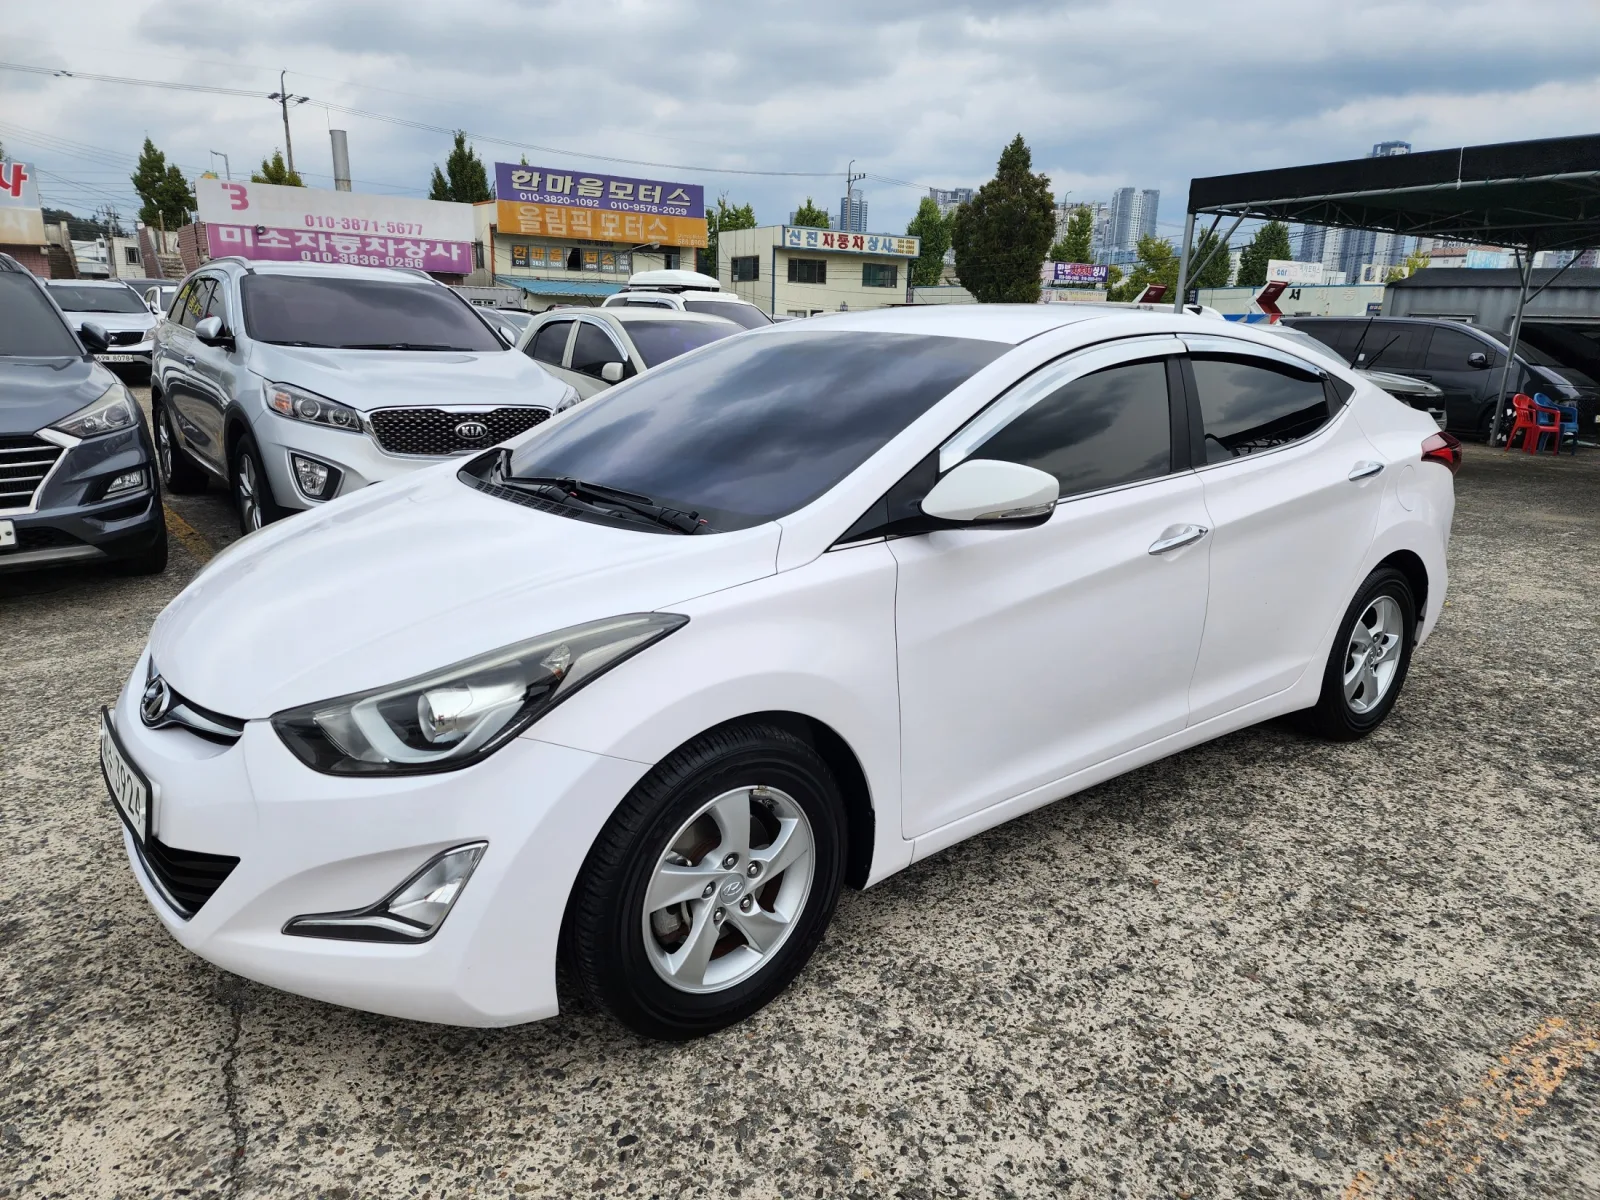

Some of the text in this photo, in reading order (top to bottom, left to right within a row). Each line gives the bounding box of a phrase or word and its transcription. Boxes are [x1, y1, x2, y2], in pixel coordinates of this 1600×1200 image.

[511, 170, 691, 206] 한마음모터스
[519, 192, 688, 216] 010-3820-1092 010-9578-2029
[304, 214, 423, 236] 010-3871-5677
[600, 213, 669, 241] 모터스
[218, 226, 463, 261] 미소자동차상사
[301, 250, 424, 269] 010-3836-0256
[461, 426, 484, 436] KIA
[115, 755, 141, 825] 3924
